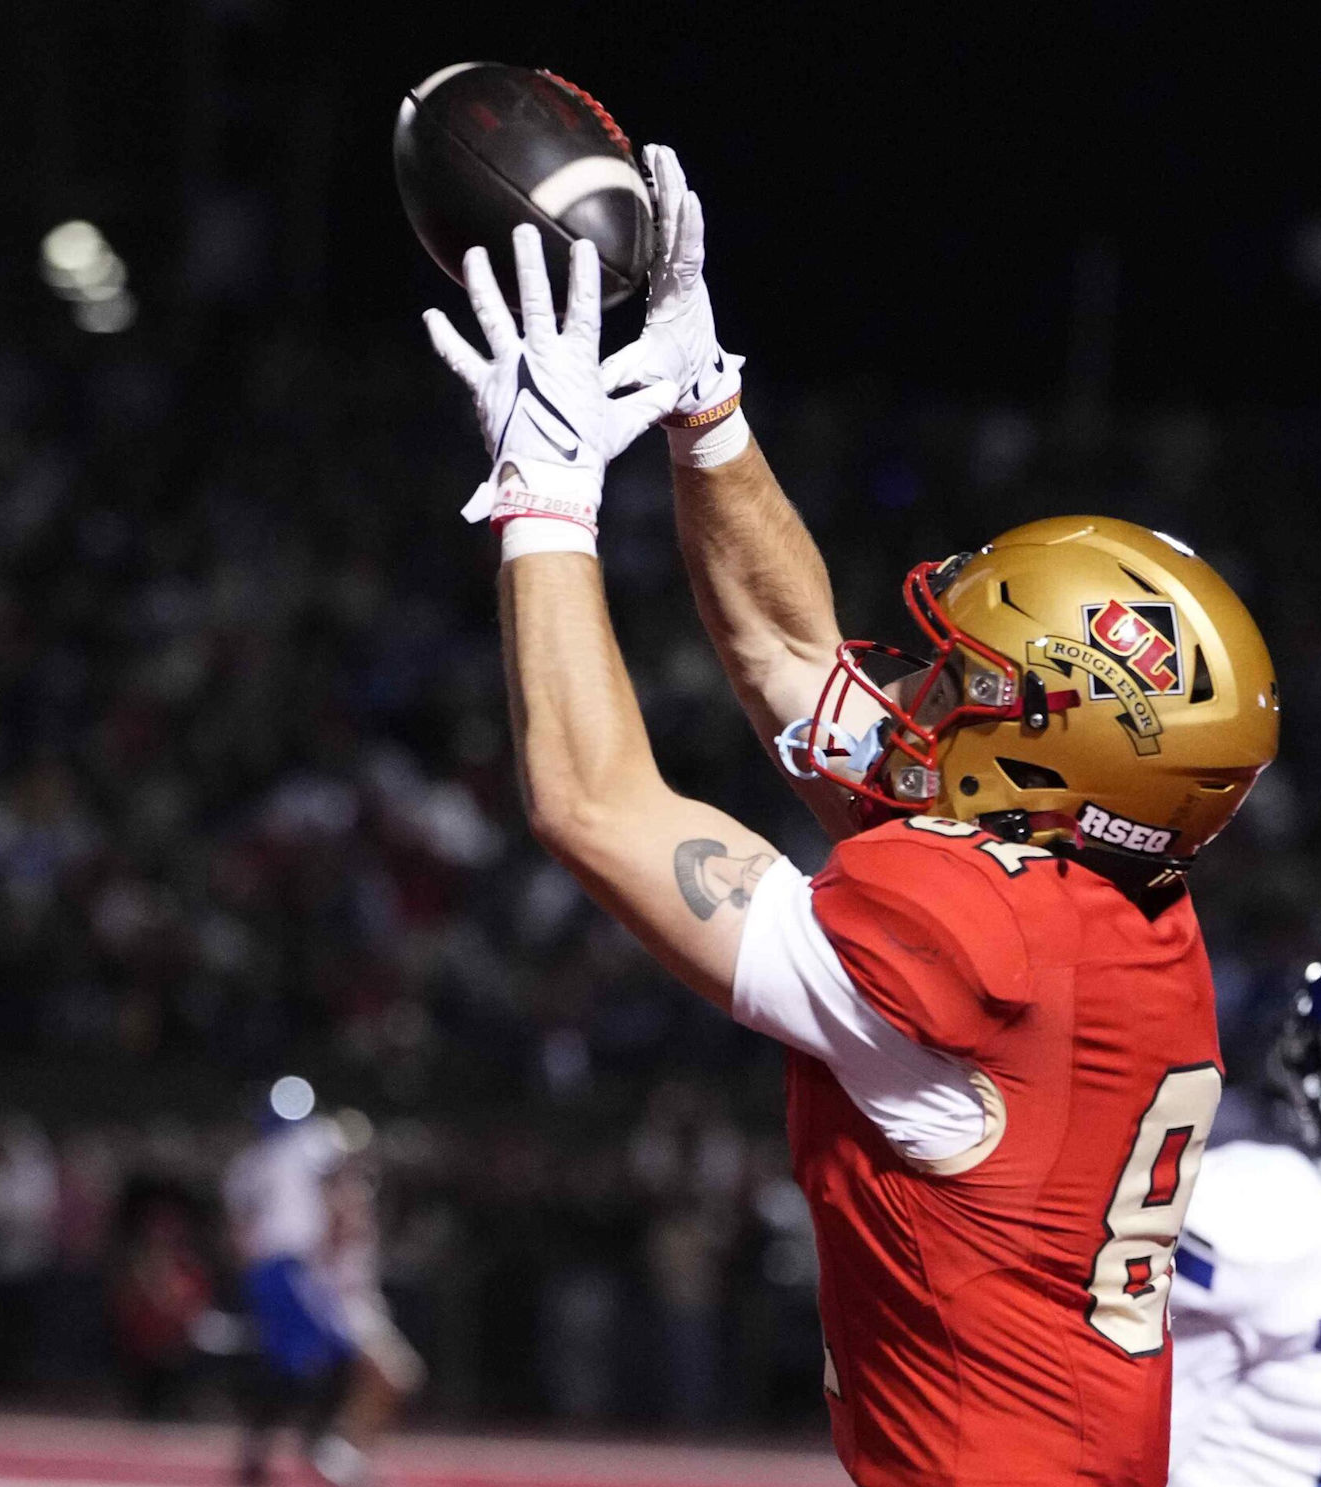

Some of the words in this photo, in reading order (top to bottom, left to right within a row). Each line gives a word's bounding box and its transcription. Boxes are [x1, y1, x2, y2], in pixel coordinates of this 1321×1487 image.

[1054, 642, 1118, 681] ROUGE
[1116, 679, 1138, 699] ET
[1134, 702, 1153, 729] OR
[1091, 599, 1177, 692] UL
[1083, 1060, 1226, 1358] 8
